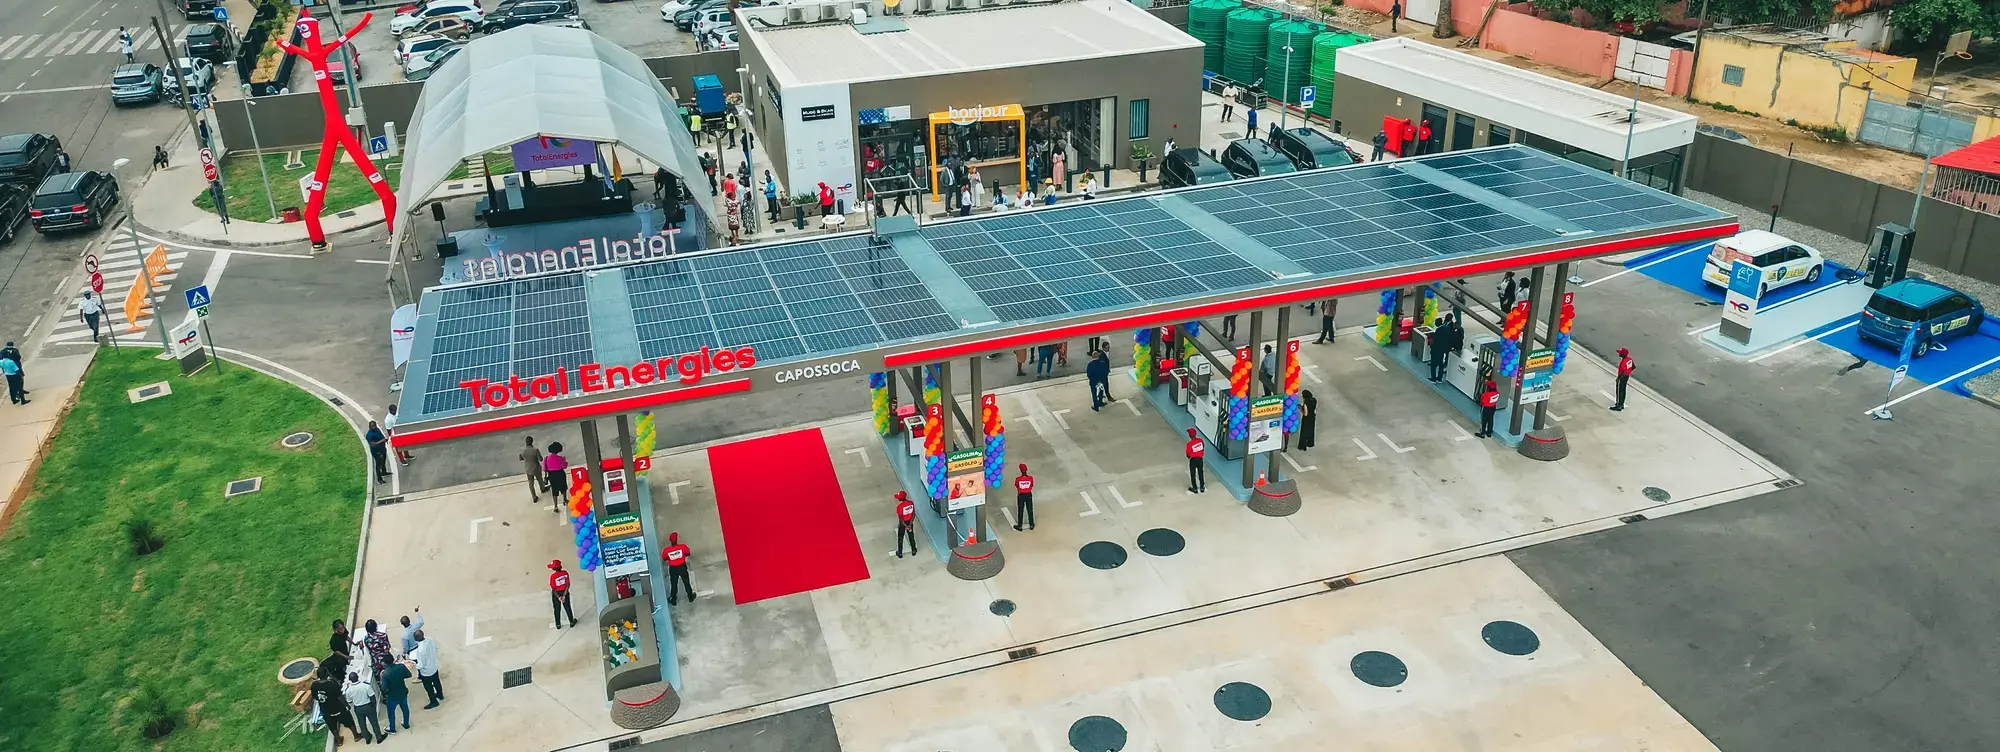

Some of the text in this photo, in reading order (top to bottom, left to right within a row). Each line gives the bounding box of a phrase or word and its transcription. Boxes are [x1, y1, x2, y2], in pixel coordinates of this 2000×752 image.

[1303, 88, 1313, 101] P
[948, 103, 1009, 122] bonjour
[531, 151, 578, 162] TotalEnergies
[205, 168, 216, 177] STOP
[93, 277, 102, 289] STOP
[1565, 295, 1571, 303] 8
[1521, 302, 1527, 311] 7
[1290, 343, 1297, 351] 6
[1241, 351, 1247, 360] 5
[774, 359, 861, 384] CAPOSSOCA
[985, 396, 992, 405] 4
[1256, 397, 1280, 406] GASOLINA
[932, 406, 939, 416] 3
[953, 451, 979, 460] GASOLINA
[639, 459, 647, 469] 2
[576, 470, 583, 479] 1
[604, 515, 634, 526] GASOLINA
